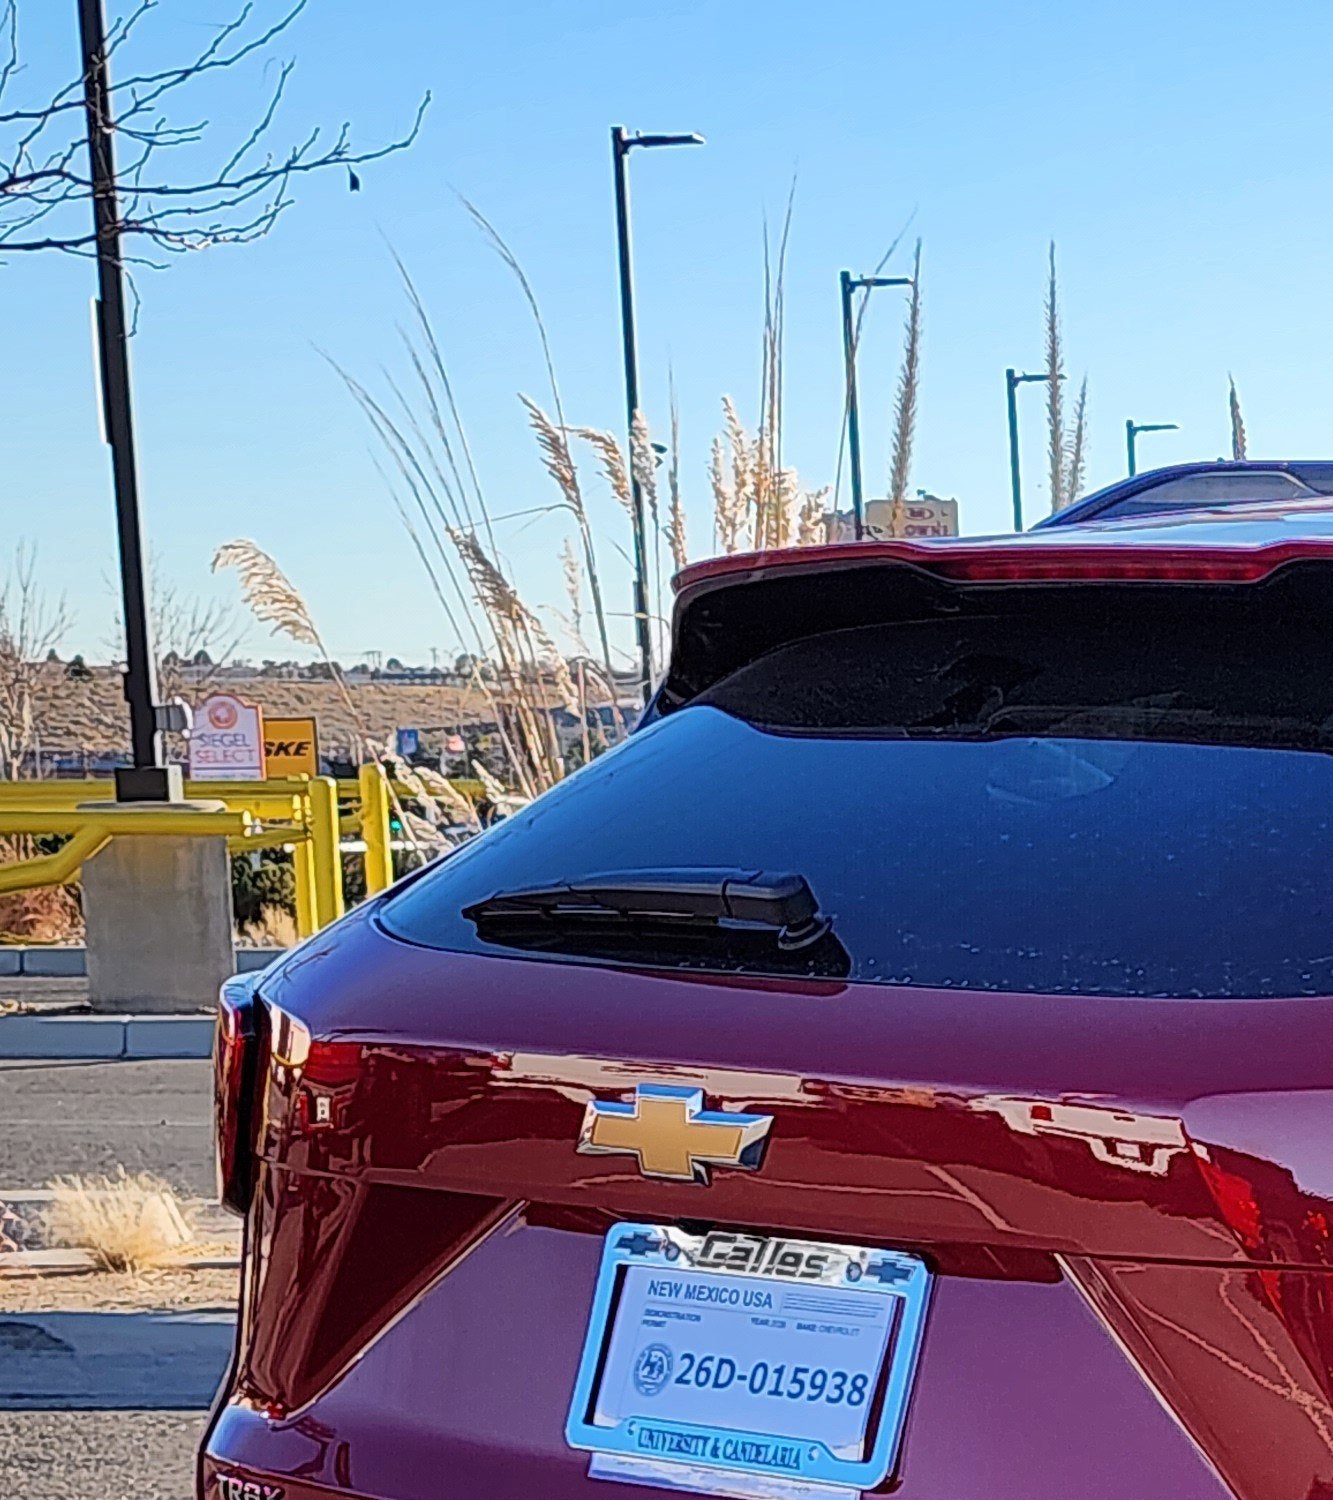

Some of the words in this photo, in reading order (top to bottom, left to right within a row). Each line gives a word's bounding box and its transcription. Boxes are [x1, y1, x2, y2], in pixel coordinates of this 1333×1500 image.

[195, 749, 255, 763] SELECT
[696, 1234, 829, 1279] Galles
[647, 1280, 683, 1299] NEW
[684, 1283, 740, 1306] MEXICO
[742, 1290, 773, 1310] USA
[674, 1352, 869, 1407] 26D-015938
[638, 1427, 711, 1457] UNIVERSITY
[710, 1437, 720, 1459] &
